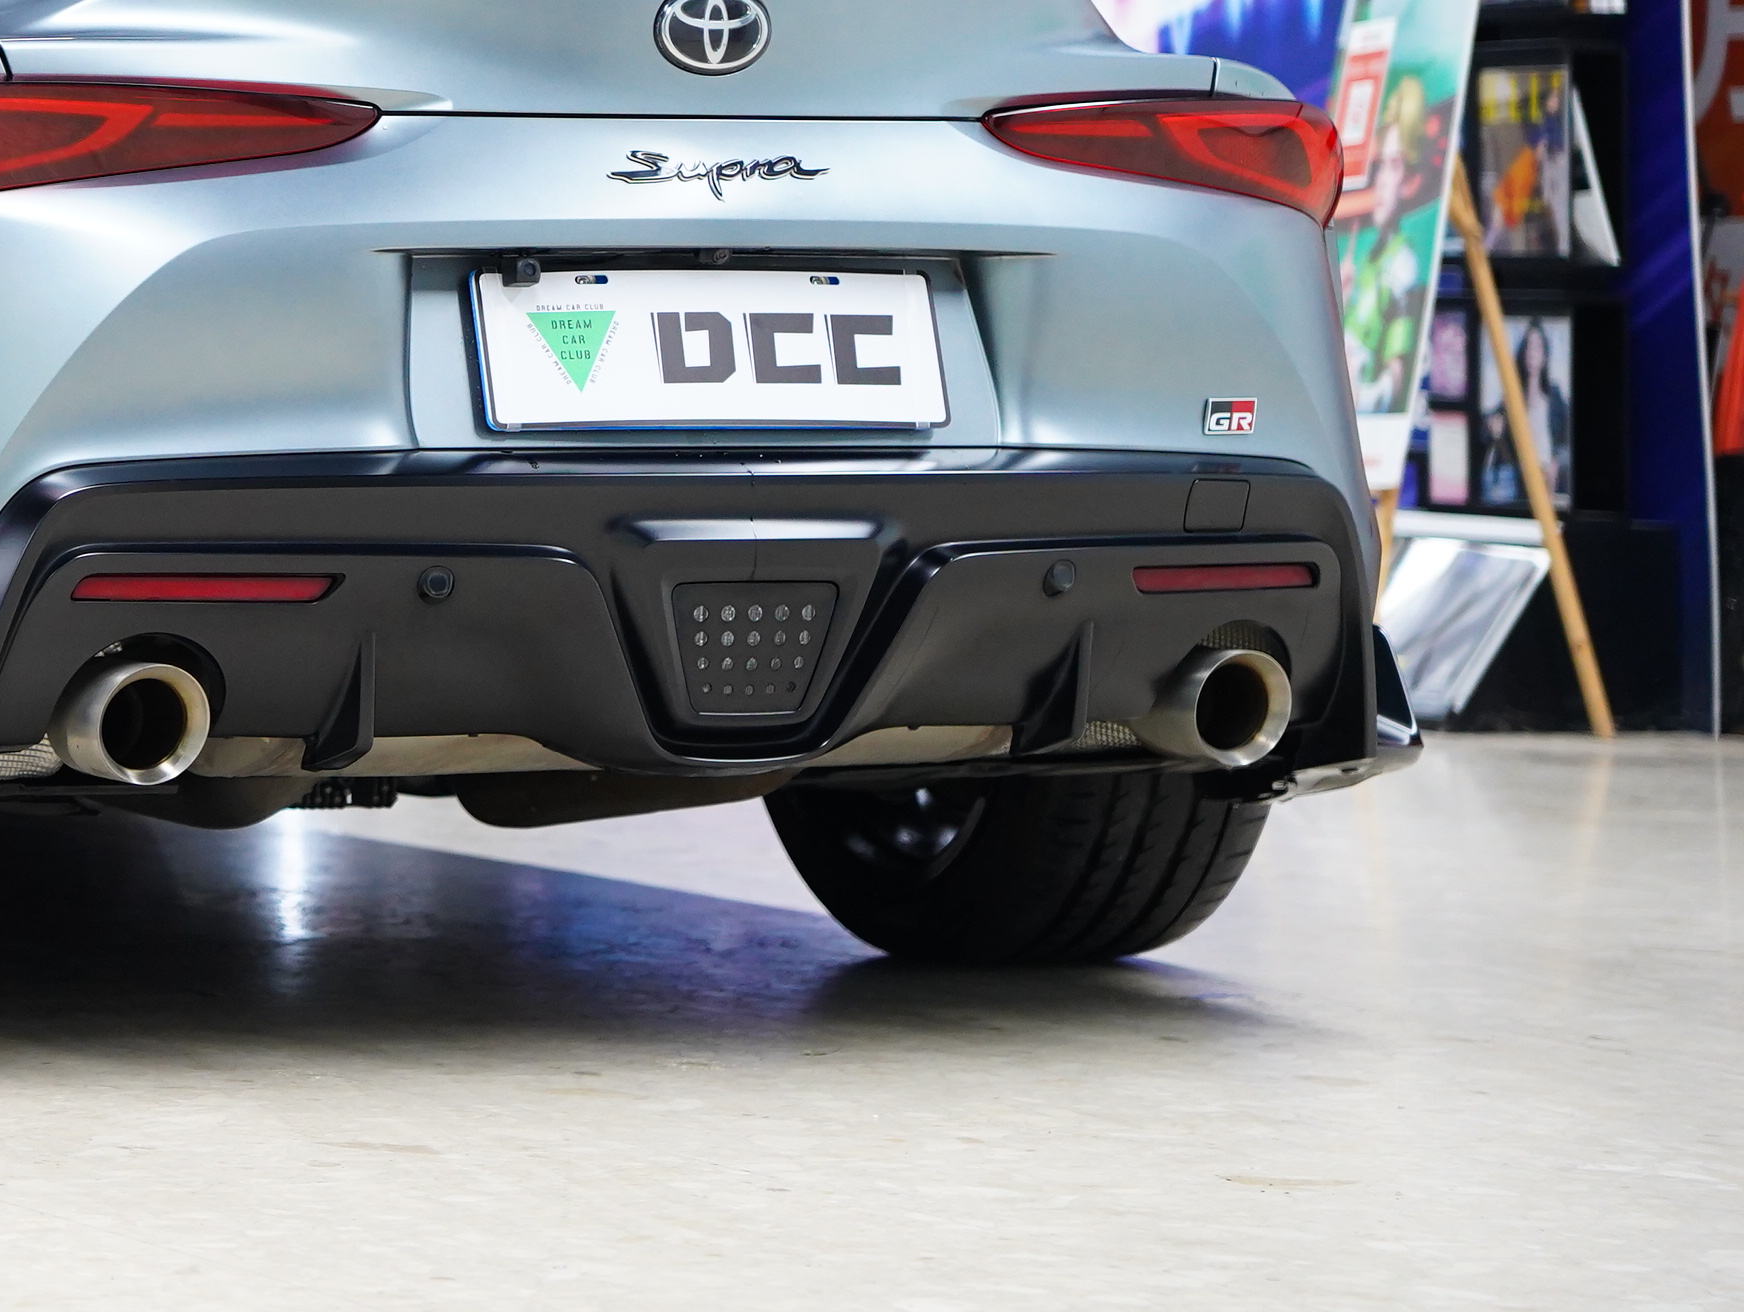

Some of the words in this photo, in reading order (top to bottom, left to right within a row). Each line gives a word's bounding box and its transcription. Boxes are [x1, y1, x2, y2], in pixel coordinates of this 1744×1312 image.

[606, 150, 831, 202] Supra
[551, 319, 592, 330] DREAM
[562, 334, 586, 345] CAR
[560, 349, 591, 360] CLUB
[650, 312, 901, 385] DCC
[1209, 412, 1253, 431] GR
